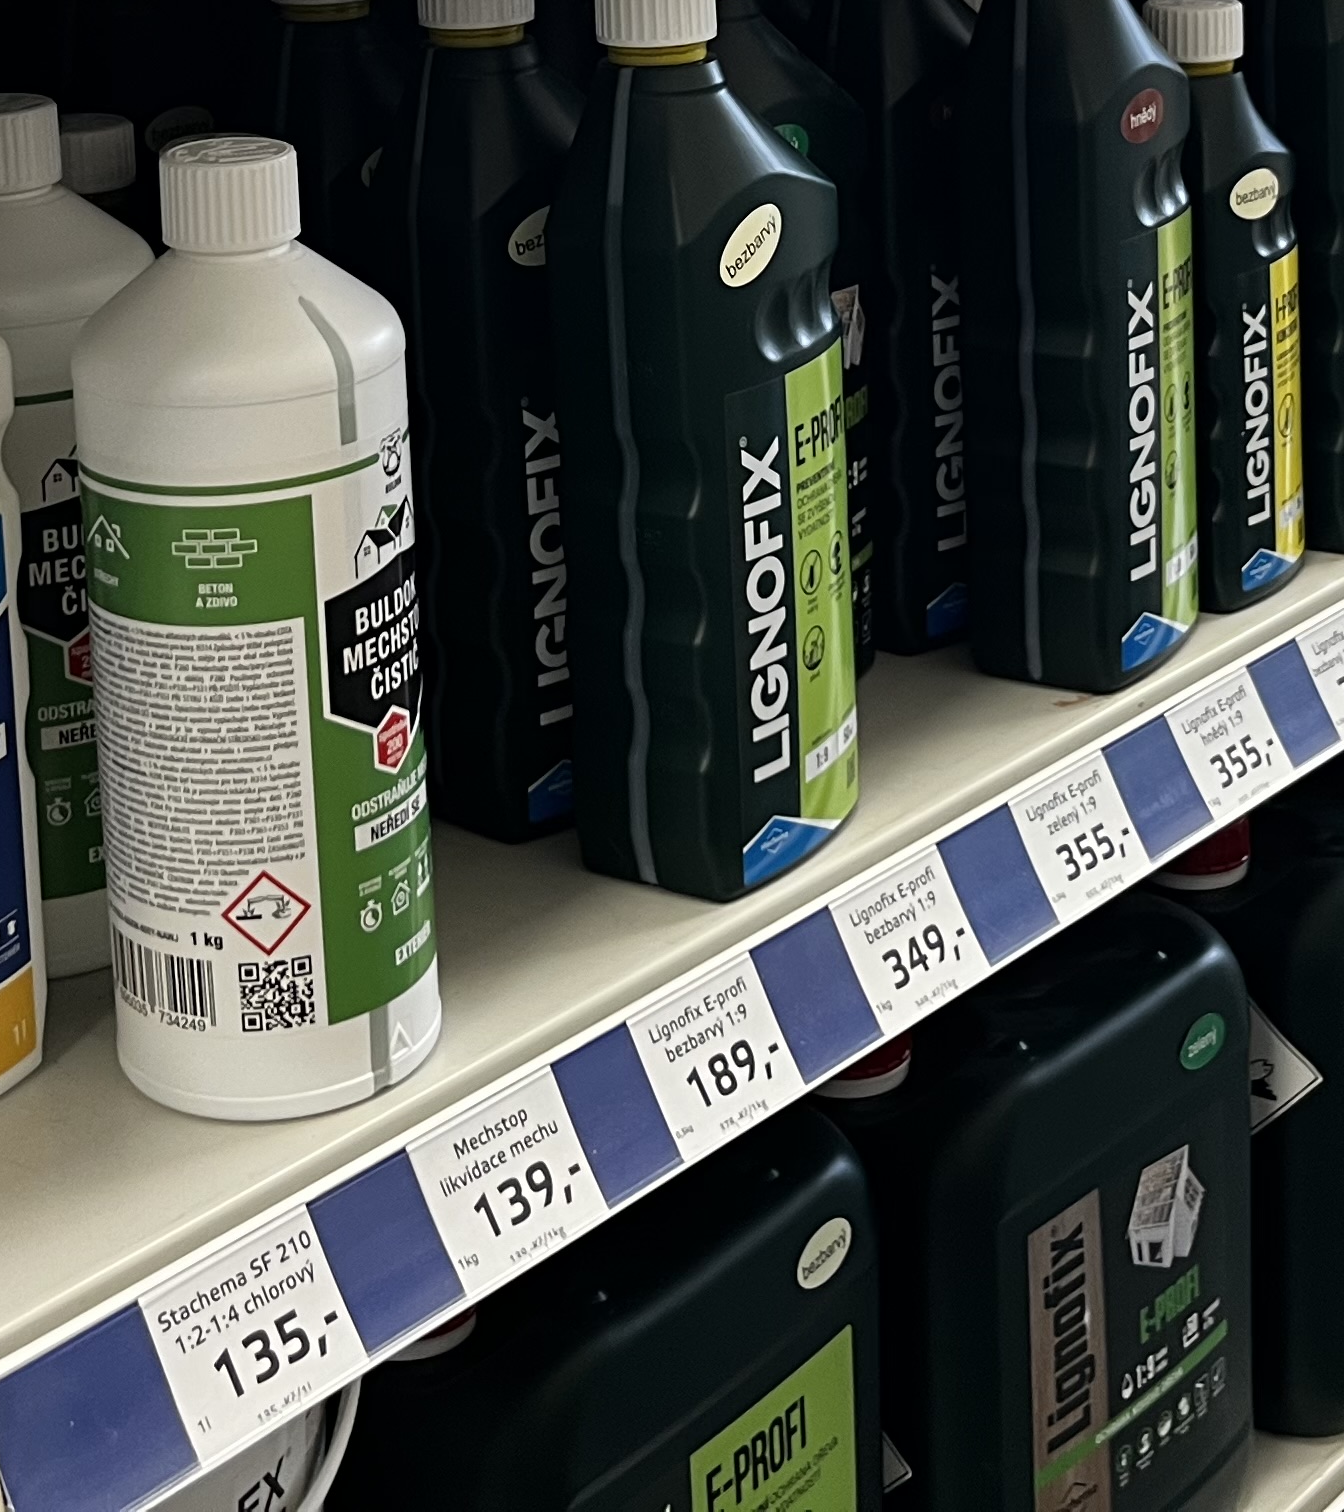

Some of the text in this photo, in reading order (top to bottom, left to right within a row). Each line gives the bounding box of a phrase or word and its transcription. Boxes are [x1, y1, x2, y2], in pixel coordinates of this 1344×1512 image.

[723, 214, 781, 281] bezbarvý
[1127, 281, 1157, 582] LIGNOFIX
[1243, 303, 1271, 527] LIGNOFIX
[195, 594, 238, 609] A ZDIVO
[198, 582, 233, 596] BETON
[740, 434, 791, 784] LIGNOFIX
[342, 606, 420, 677] MECHSTO
[1209, 735, 1276, 790] 355,-
[370, 804, 408, 844] NEŘEDÍ
[1055, 823, 1131, 883] 355,-
[189, 930, 224, 951] 1 kg
[881, 923, 967, 991] 349,-
[648, 976, 749, 1047] Lignofix E-profi
[665, 1003, 748, 1065] bezbarvý 1:9
[685, 1038, 780, 1109] 189,-
[439, 1118, 559, 1196] likvidace mechu
[452, 1105, 529, 1160] Mechstop
[473, 1159, 582, 1239] 139,-
[157, 1228, 313, 1333] Stachema SF 210
[174, 1259, 317, 1355] 1:2-1:4 chlorový
[212, 1308, 339, 1399] 135,-
[703, 1393, 808, 1512] E-PROFI
